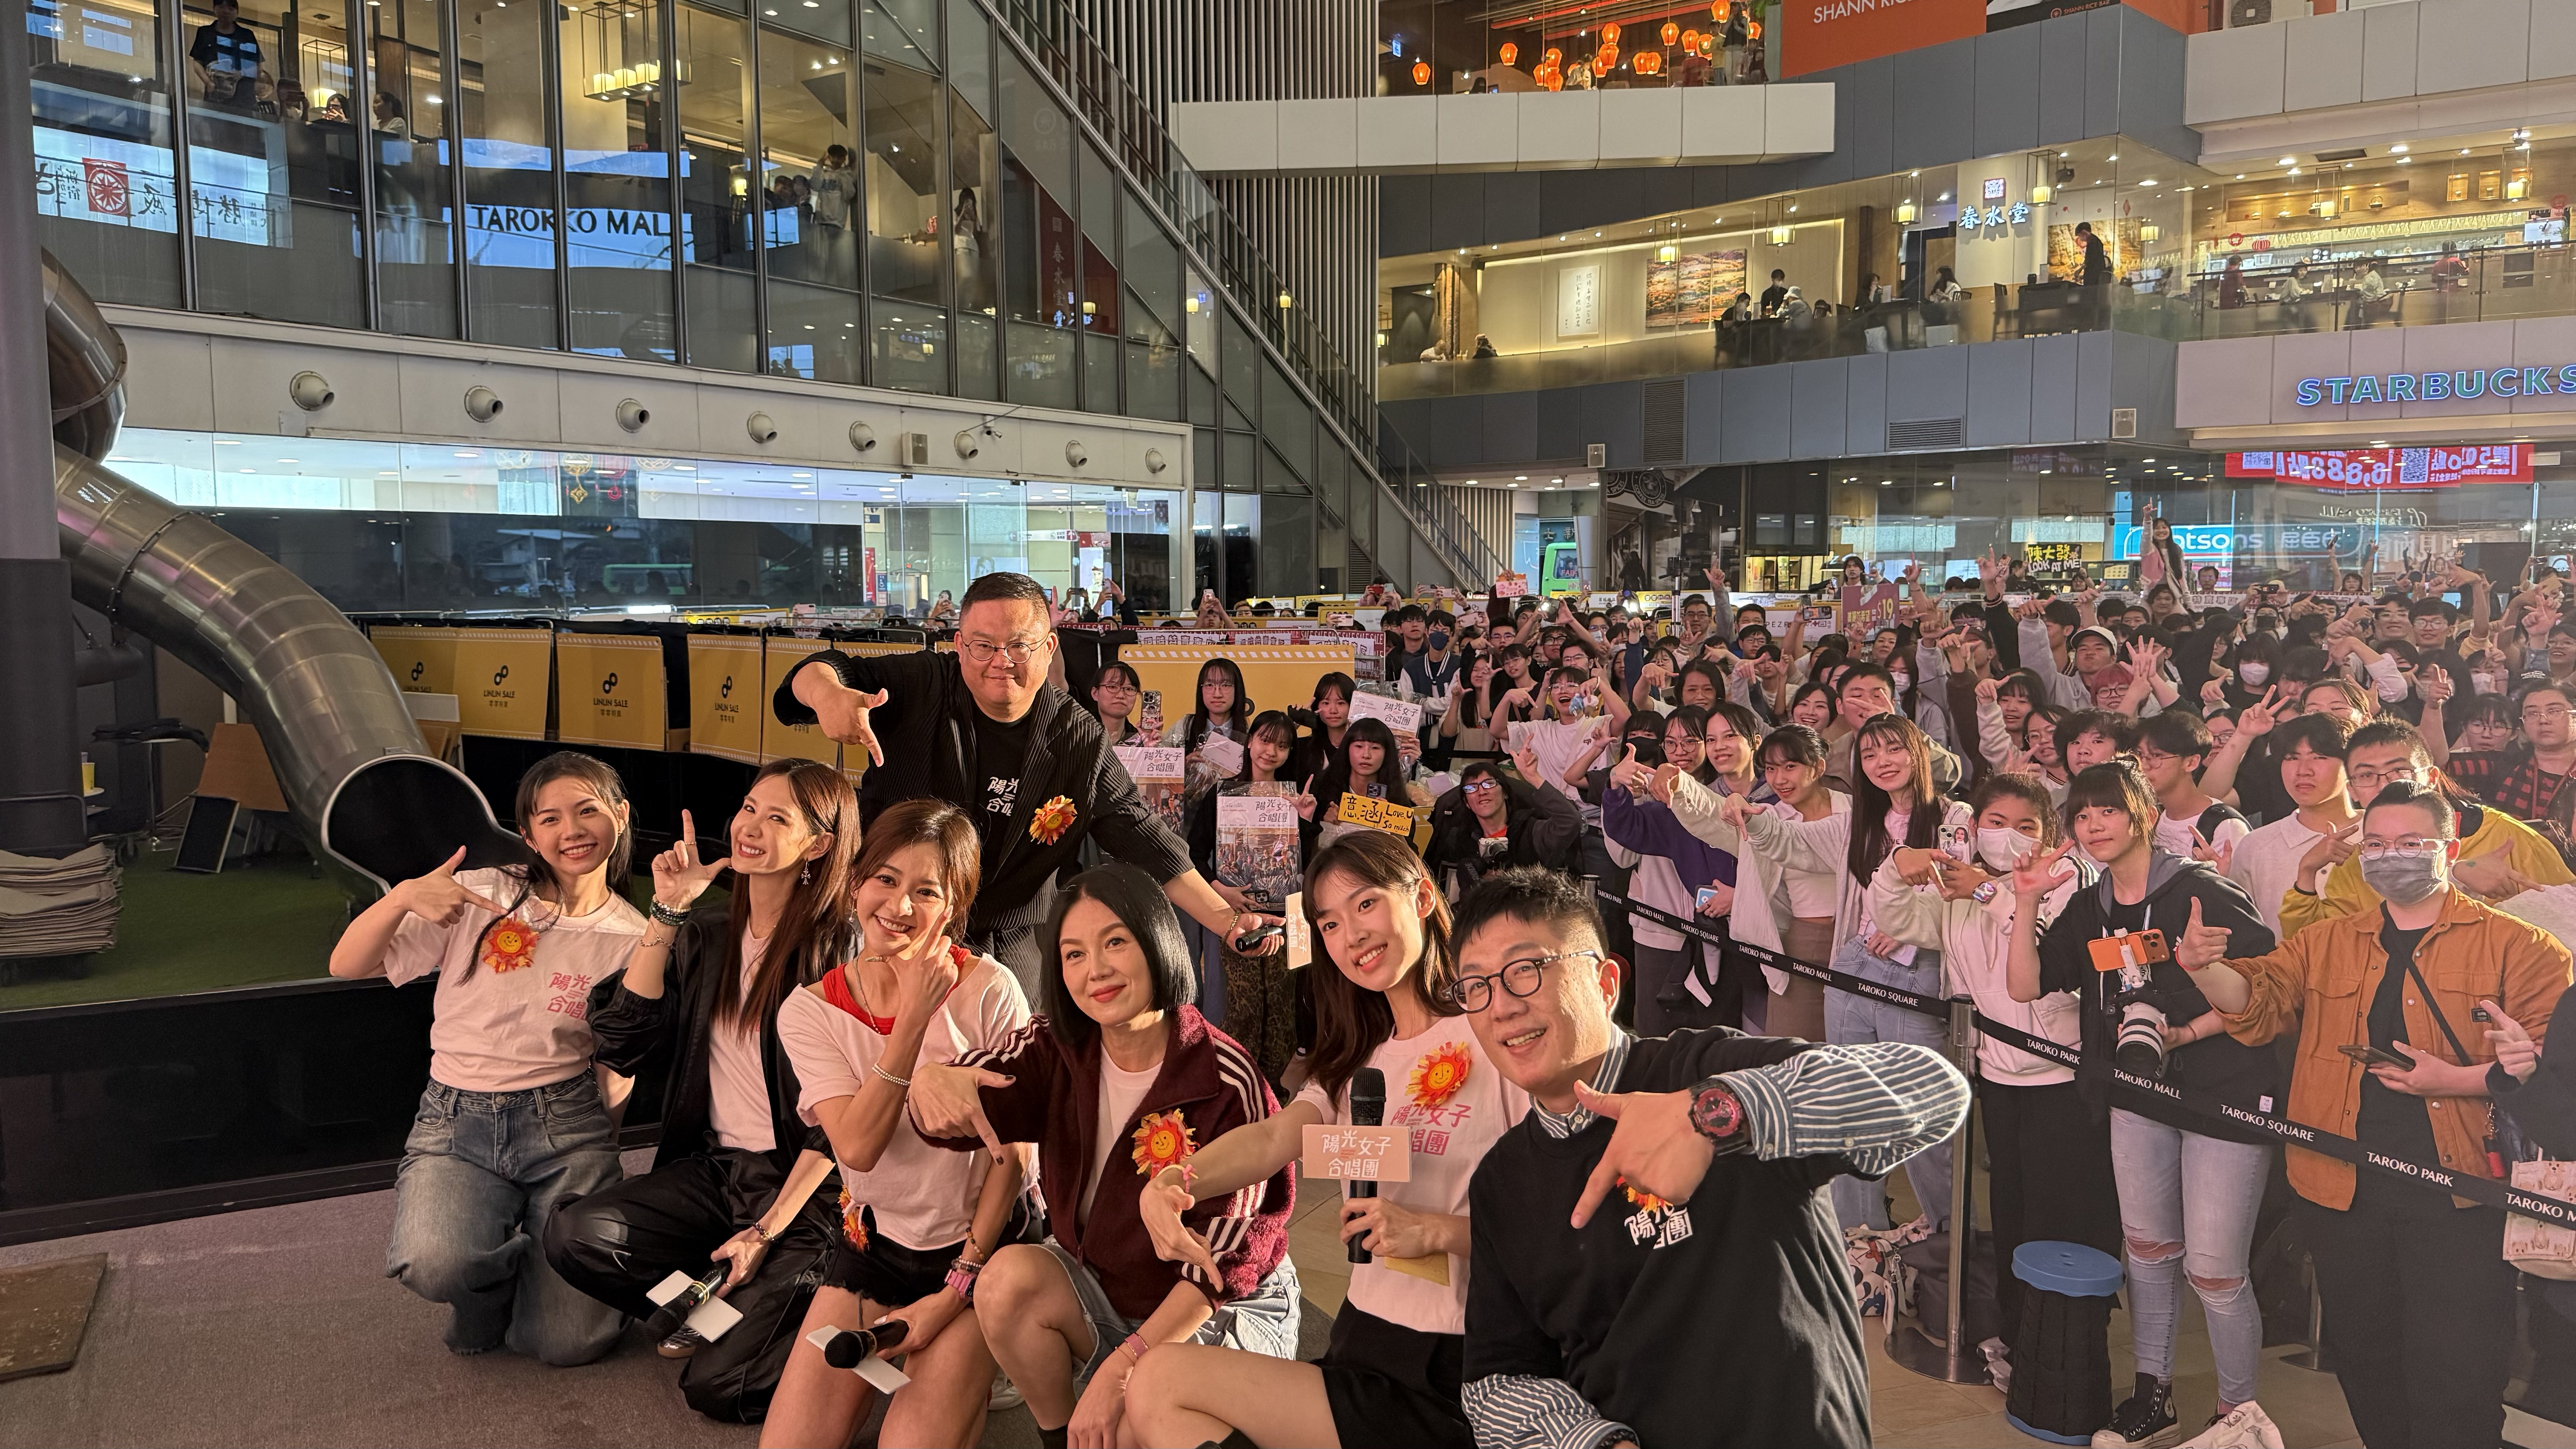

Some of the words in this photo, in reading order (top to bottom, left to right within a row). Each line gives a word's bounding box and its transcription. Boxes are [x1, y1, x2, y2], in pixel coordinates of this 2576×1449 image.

[1813, 0, 1874, 24] SHANN
[2099, 0, 2110, 8] BAR
[1958, 201, 2029, 230] 春水堂
[2296, 363, 2576, 406] STARBUCKS
[2175, 532, 2263, 551] atsons
[2028, 544, 2070, 563] 陳大發
[2028, 560, 2050, 573] LOOK
[2052, 561, 2061, 572] AT
[2063, 558, 2082, 570] ME!
[593, 698, 612, 706] LINLIN
[614, 699, 628, 708] SALE
[715, 702, 728, 711] LINLIN
[729, 704, 739, 713] SALE
[1384, 702, 1419, 717] 陽光女子
[1385, 713, 1411, 726] 合唱團
[1144, 749, 1182, 762] 陽光女子
[1146, 762, 1174, 773] 合唱團
[1255, 798, 1294, 812] 陽光女子
[1258, 812, 1287, 823] 合唱團
[1597, 889, 1612, 901] TAROKO
[1612, 894, 1622, 905] PARK
[1636, 905, 1652, 917] TAROKO
[1653, 911, 1665, 923] MALL
[1681, 922, 1699, 935] TAROKO
[1699, 930, 1719, 943] SQUARE
[1739, 944, 1759, 957] TAROKO
[1760, 951, 1773, 962] PARK
[549, 972, 592, 991] 陽光
[1793, 962, 1815, 977] TAROKO
[1815, 969, 1832, 982] MALL
[1858, 982, 1886, 999] TAROKO
[1887, 990, 1919, 1007] SQUARE
[547, 995, 586, 1021] 合唱
[2026, 1038, 2058, 1057] TAROKO
[2059, 1049, 2080, 1065] PARK
[2113, 1068, 2152, 1089] TAROKO
[2153, 1081, 2182, 1100] MALL
[2221, 1104, 2265, 1127] TAROKO
[2267, 1118, 2315, 1142] SQUARE
[1321, 1129, 1392, 1156] 陽光女子
[1328, 1158, 1380, 1178] 合唱團
[2367, 1151, 2418, 1176] TAROKO
[2420, 1168, 2454, 1187] PARK
[2505, 1193, 2563, 1218] TAROKO
